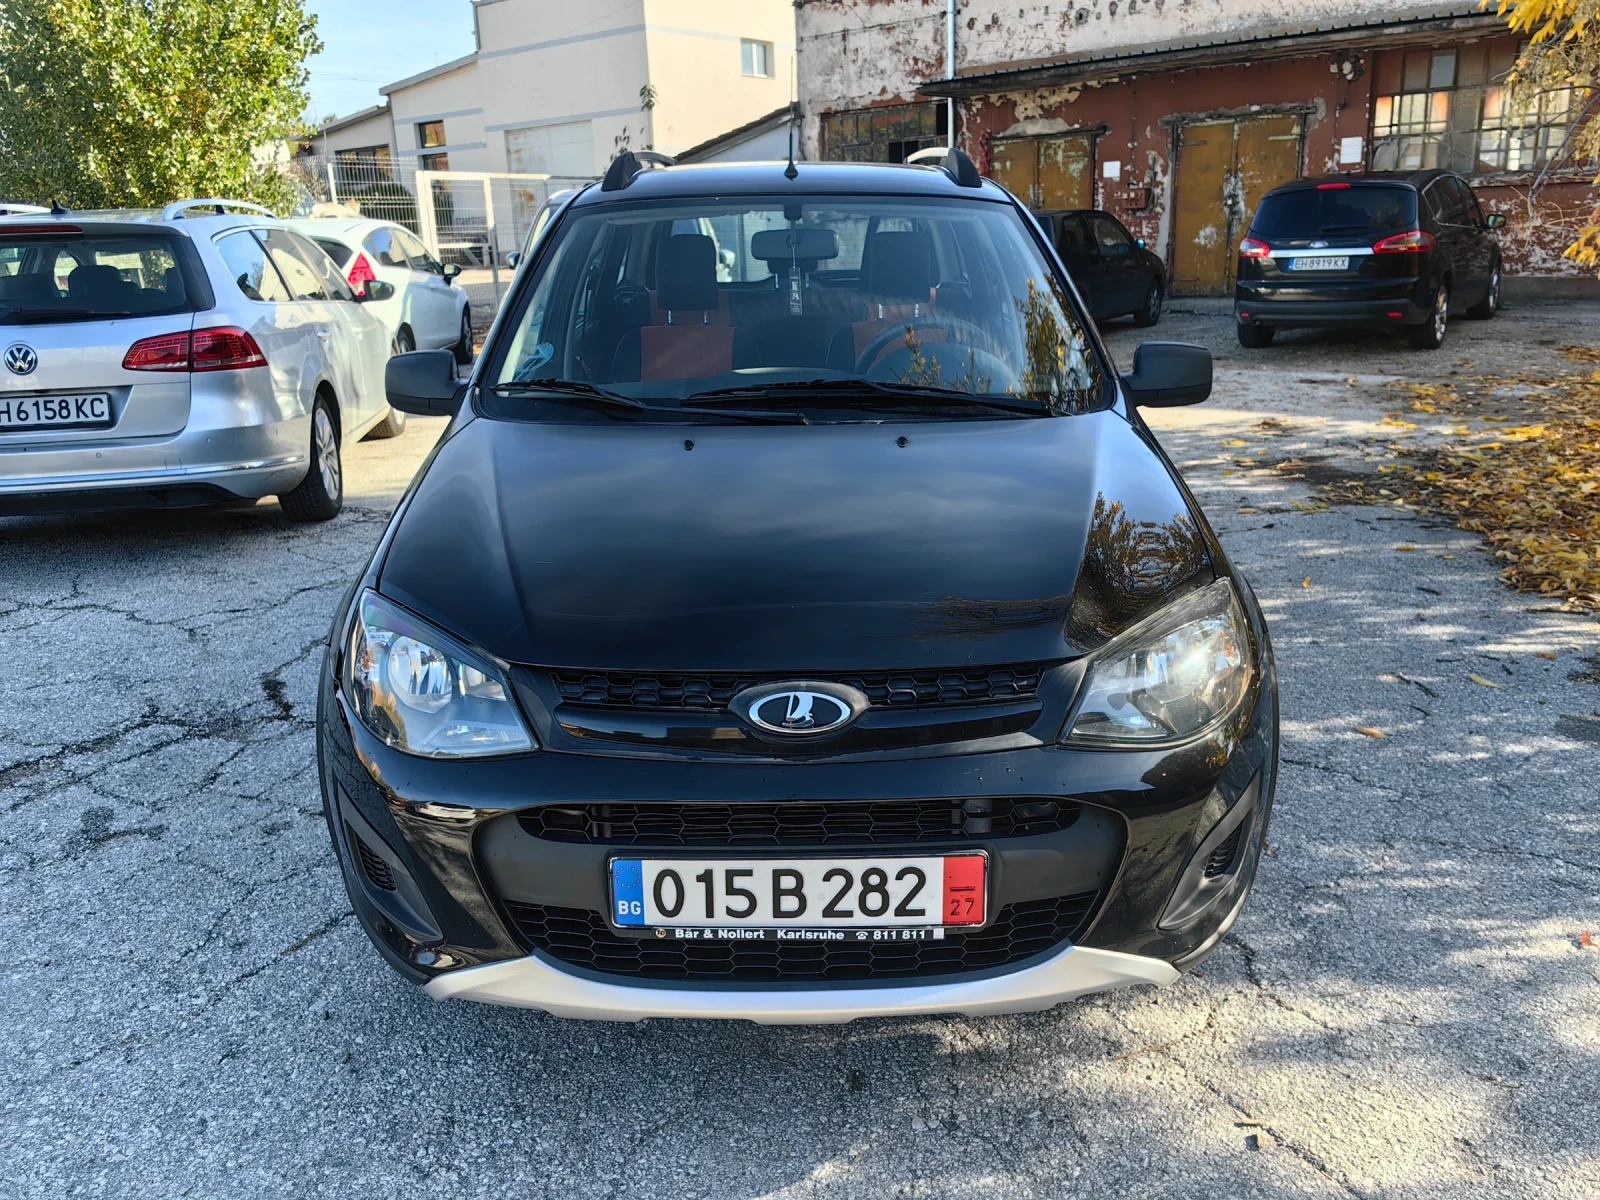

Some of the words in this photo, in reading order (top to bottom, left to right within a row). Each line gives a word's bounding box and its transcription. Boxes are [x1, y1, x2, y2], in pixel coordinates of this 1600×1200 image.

[618, 900, 641, 915] BG
[950, 898, 975, 915] 27
[675, 928, 700, 939] Bär
[703, 928, 714, 939] &
[718, 928, 765, 939] Nollert
[776, 929, 845, 940] Karlsruhe
[872, 929, 897, 940] 811
[901, 929, 926, 940] 811
